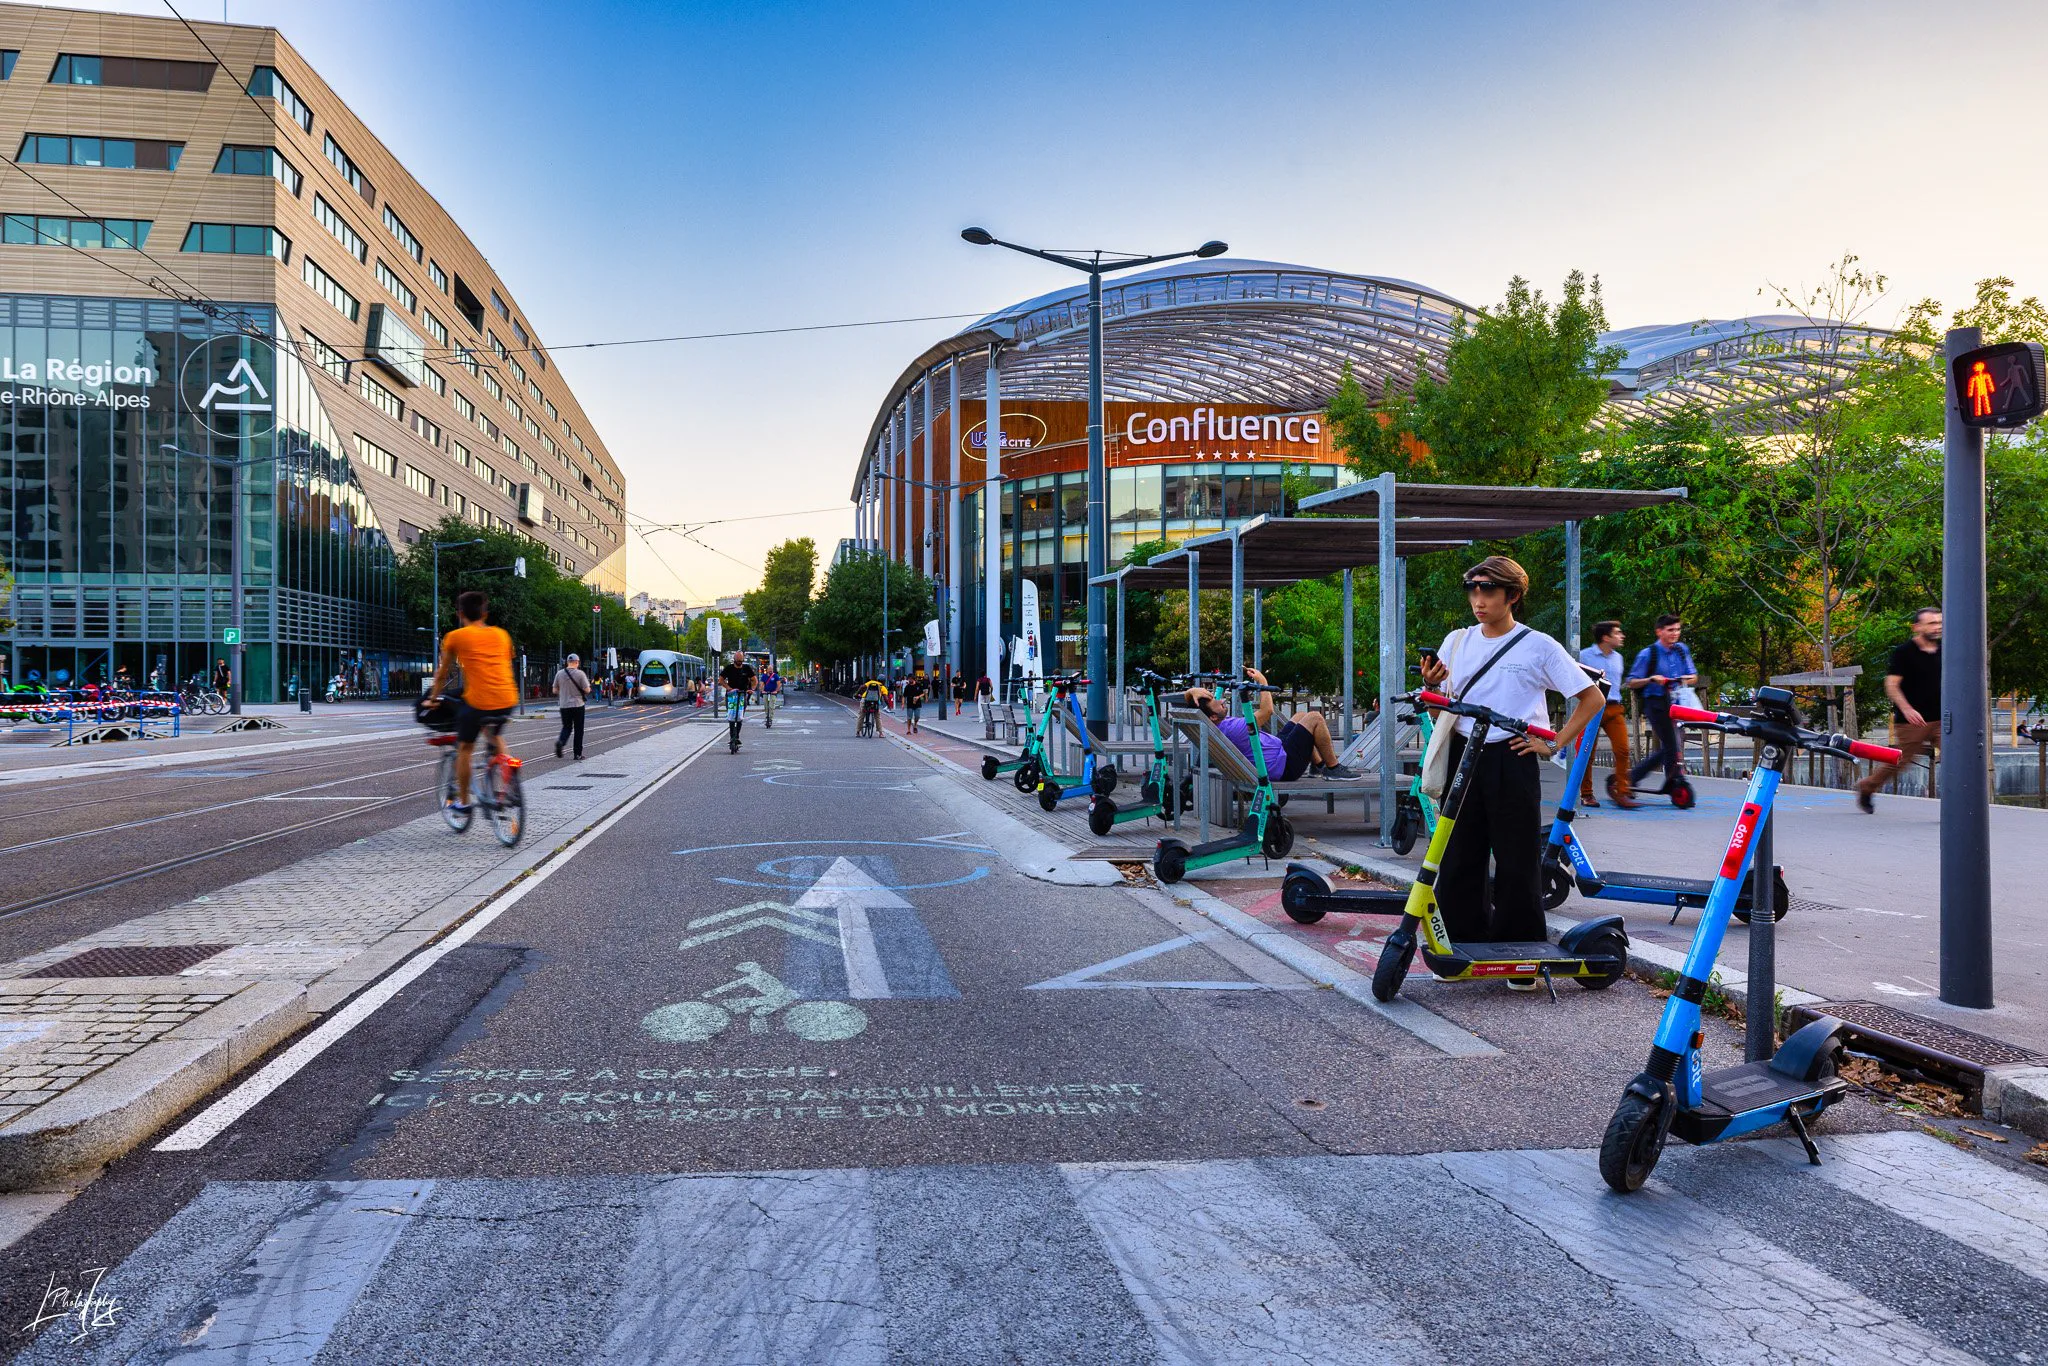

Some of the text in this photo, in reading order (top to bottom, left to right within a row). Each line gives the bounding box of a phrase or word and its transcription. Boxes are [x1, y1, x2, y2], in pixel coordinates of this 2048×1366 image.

[3, 357, 151, 387] La Région
[0, 386, 151, 411] e-Rhône-Alpes
[1127, 407, 1320, 445] Confluence
[1008, 437, 1032, 448] CITÉ
[1731, 824, 1748, 849] dott
[1569, 844, 1585, 867] dott
[1431, 916, 1446, 942] dott
[468, 1091, 545, 1105] ON
[558, 1090, 722, 1105] ROULE
[860, 1102, 925, 1118] DU
